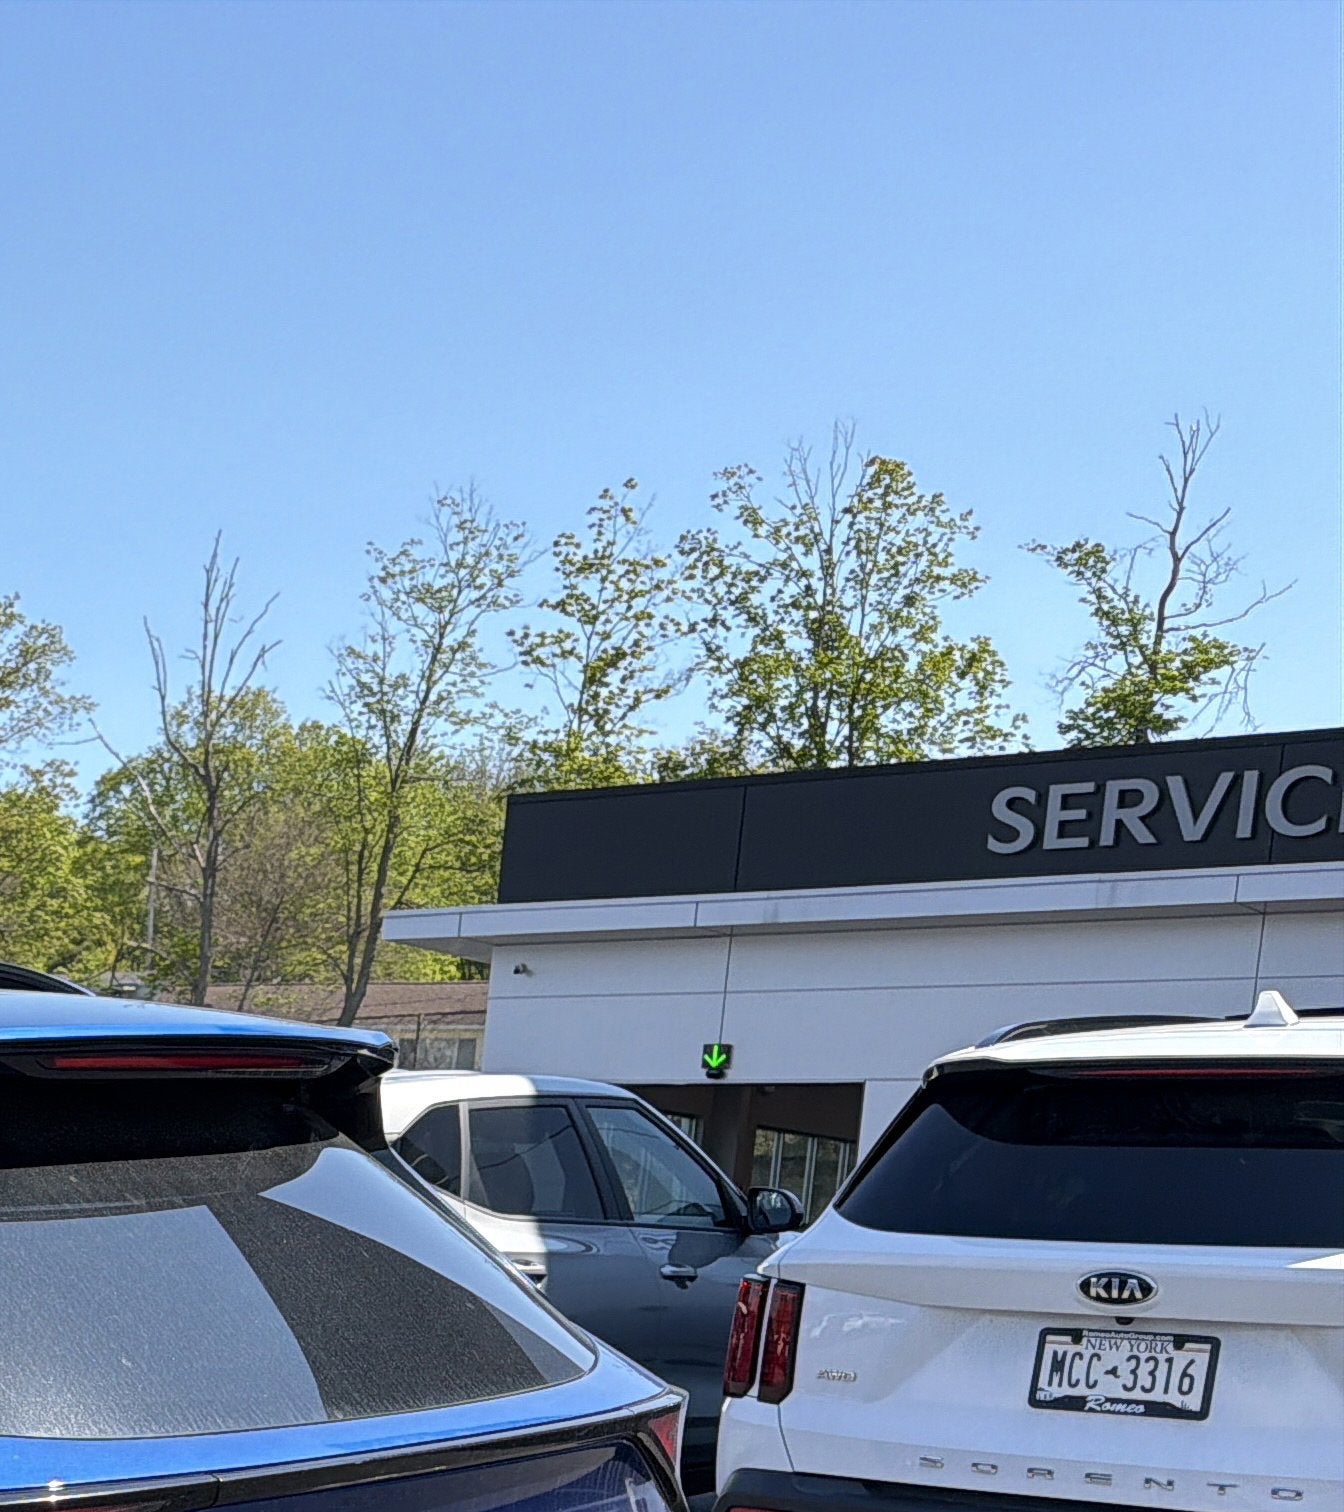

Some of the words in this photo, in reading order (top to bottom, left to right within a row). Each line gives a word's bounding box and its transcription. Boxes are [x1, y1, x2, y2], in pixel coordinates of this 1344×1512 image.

[986, 763, 1344, 854] SERVIC
[1089, 1277, 1143, 1299] KIA
[1084, 1338, 1123, 1353] NEW
[1127, 1340, 1172, 1355] YORK
[1083, 1396, 1145, 1414] Romeo
[918, 1454, 1304, 1501] SORENTO
